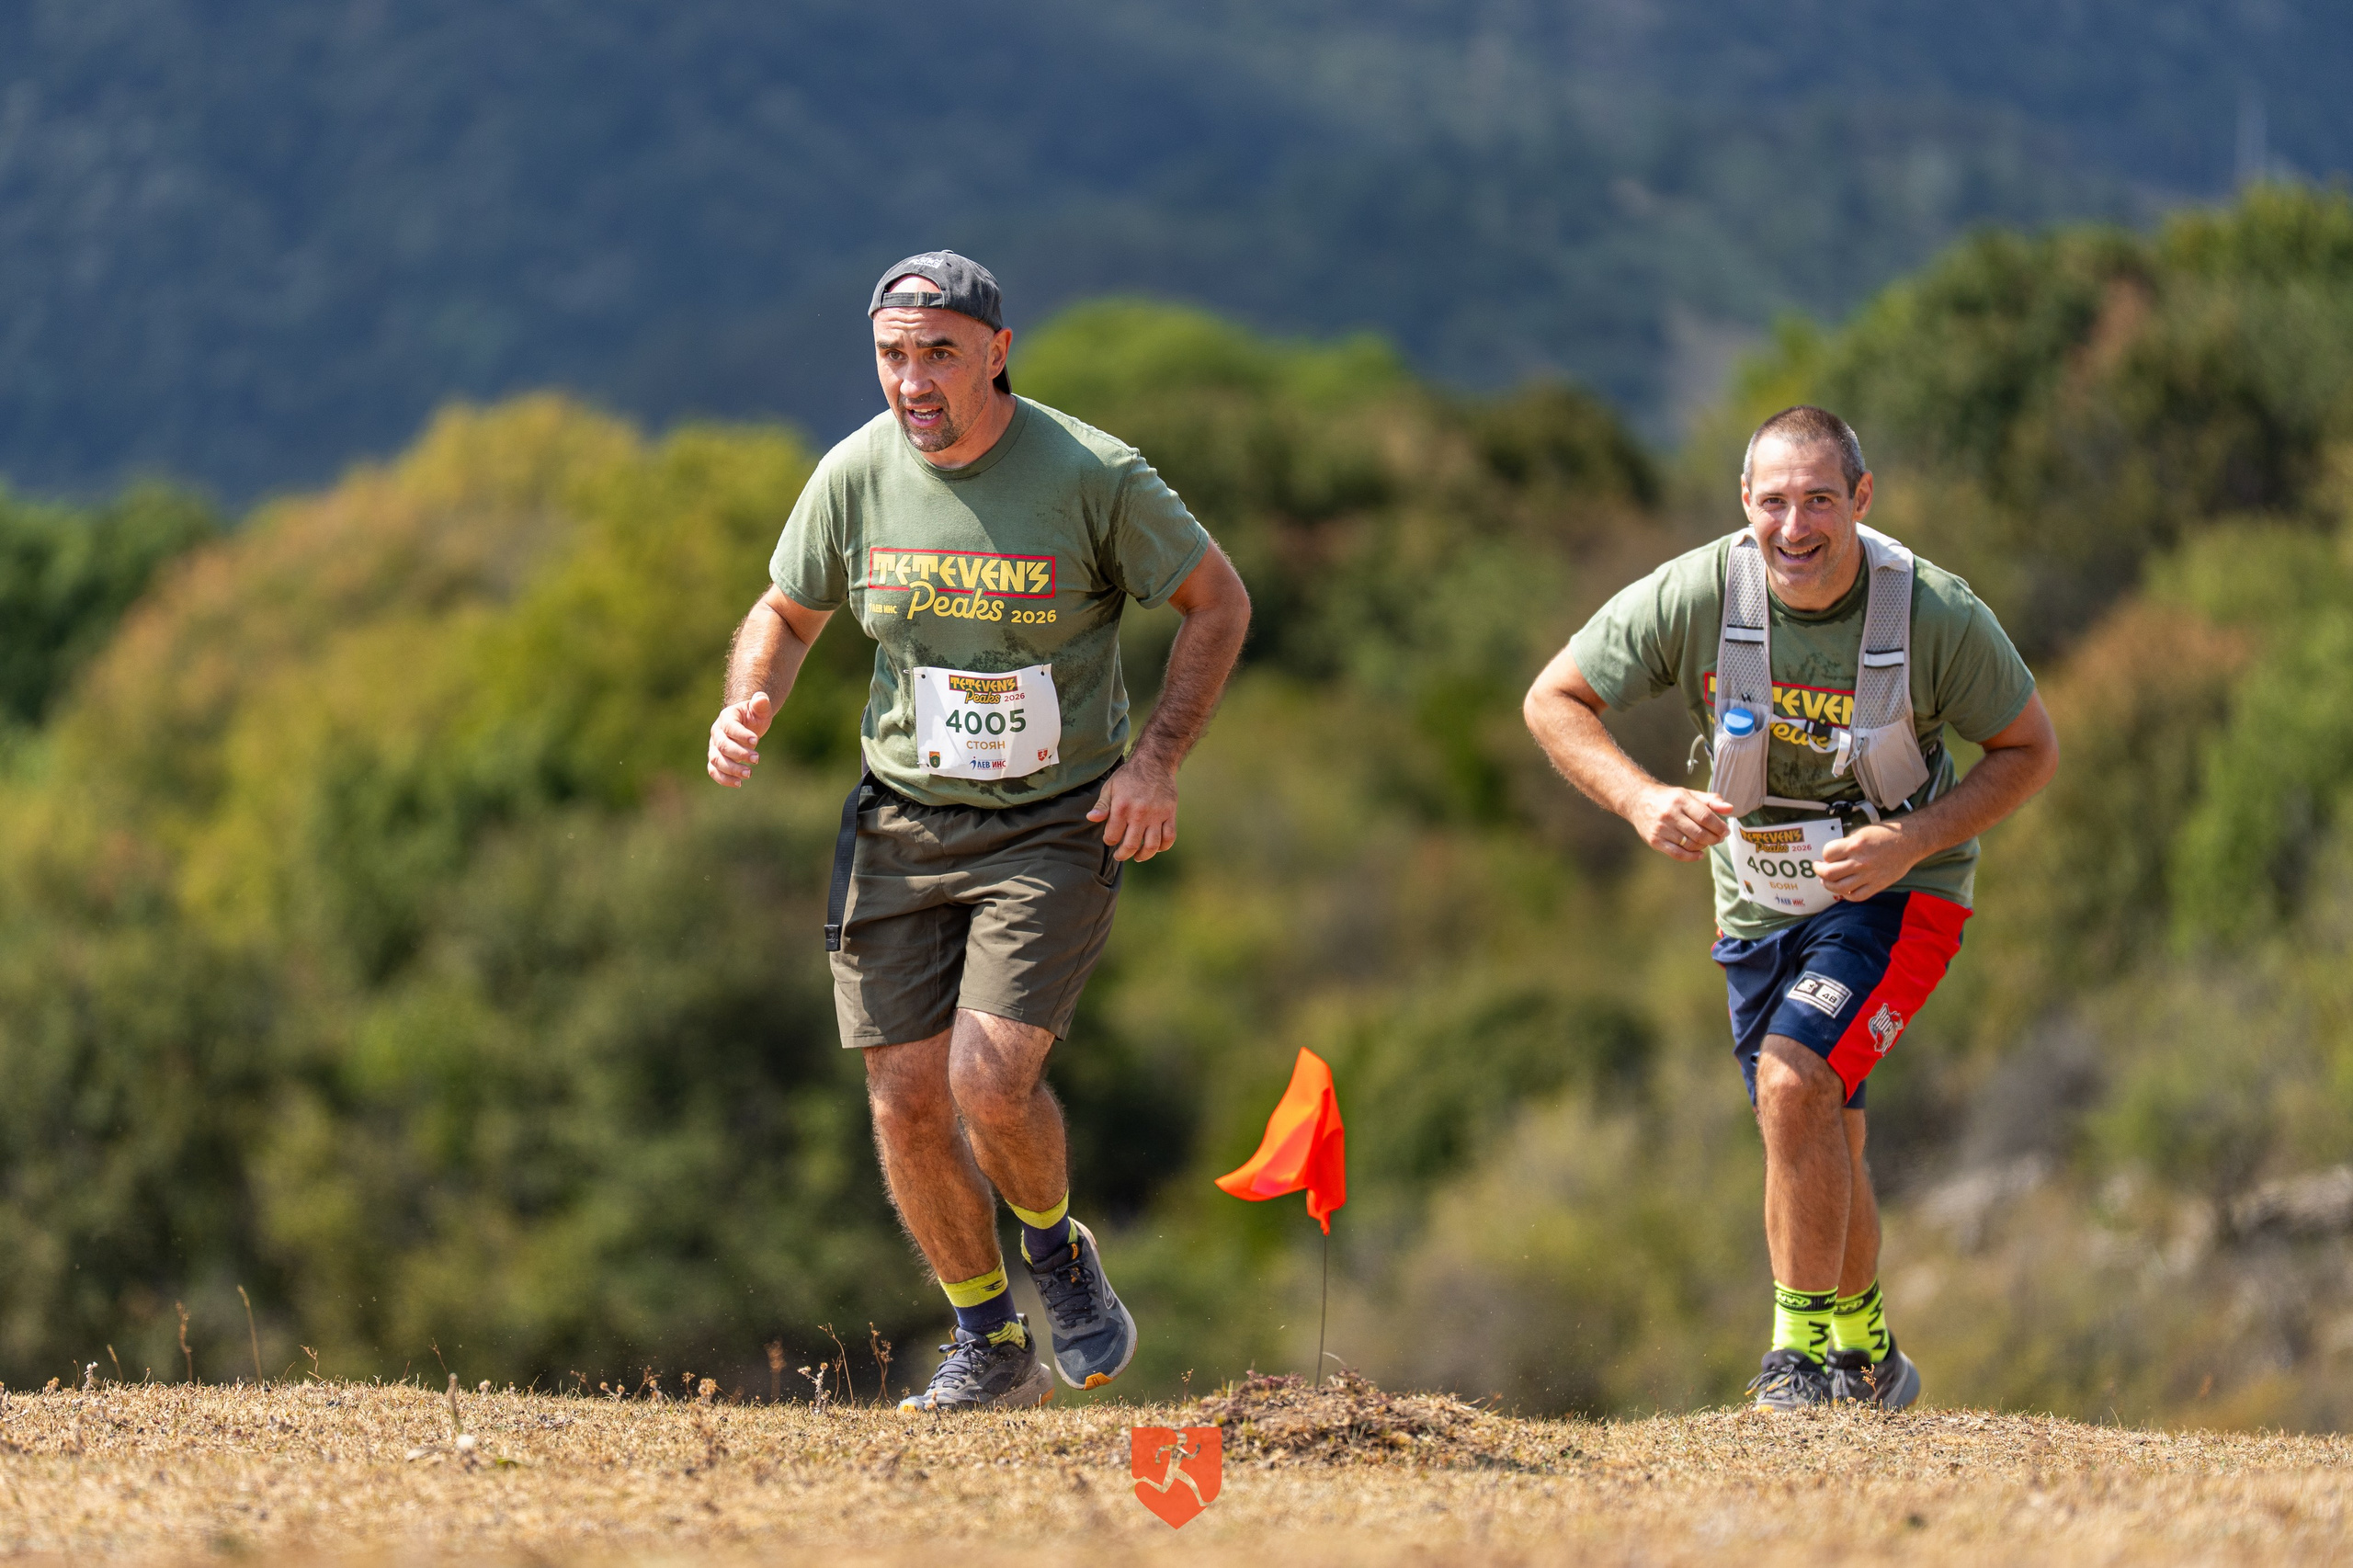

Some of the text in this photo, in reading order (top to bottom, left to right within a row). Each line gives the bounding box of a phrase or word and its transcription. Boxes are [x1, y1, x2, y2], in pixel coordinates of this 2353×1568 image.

[873, 553, 1050, 593] TETEVEN'S
[906, 581, 1057, 624] Peaks 2026
[949, 676, 1016, 692] TETEVEN'S
[964, 688, 1026, 704] Peaks 2026
[946, 708, 1027, 735] 4005
[966, 740, 1006, 750] СТОЯН
[992, 760, 1006, 768] ИНС
[1756, 841, 1813, 853] Peaks 2026
[1746, 856, 1817, 879] 4008
[1769, 881, 1799, 891] БОЯН
